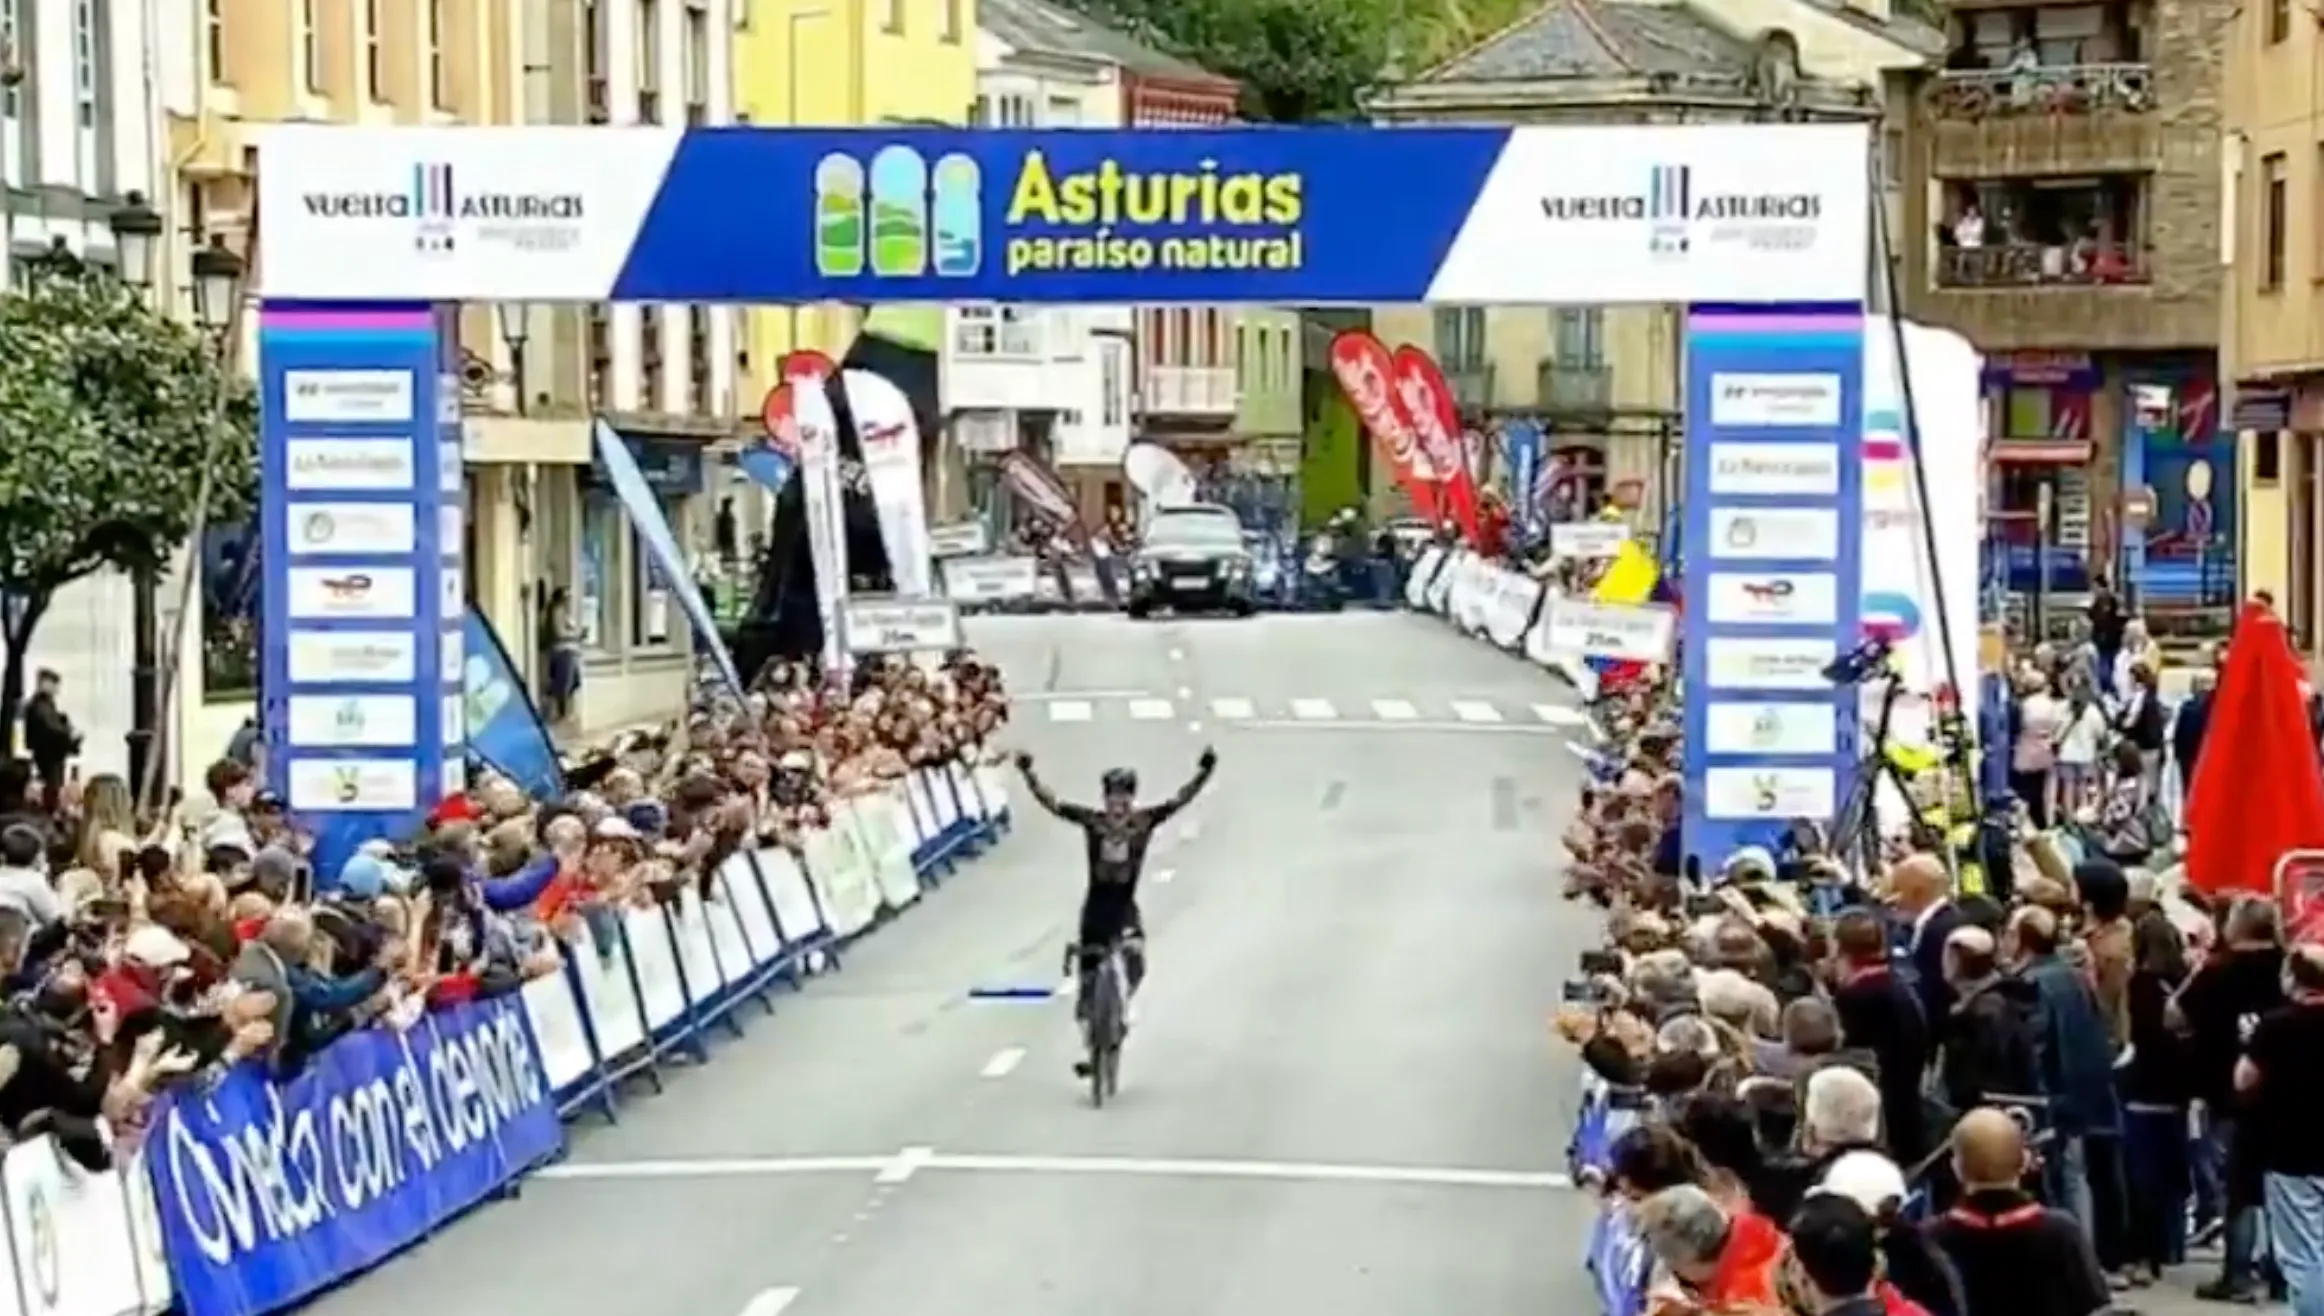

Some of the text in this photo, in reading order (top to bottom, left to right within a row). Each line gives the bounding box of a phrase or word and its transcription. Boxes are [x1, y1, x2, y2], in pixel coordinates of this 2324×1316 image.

[1005, 148, 1303, 225] Asturias
[1007, 226, 1302, 276] paraíso natural
[330, 1076, 406, 1210] con
[396, 1032, 442, 1173] el
